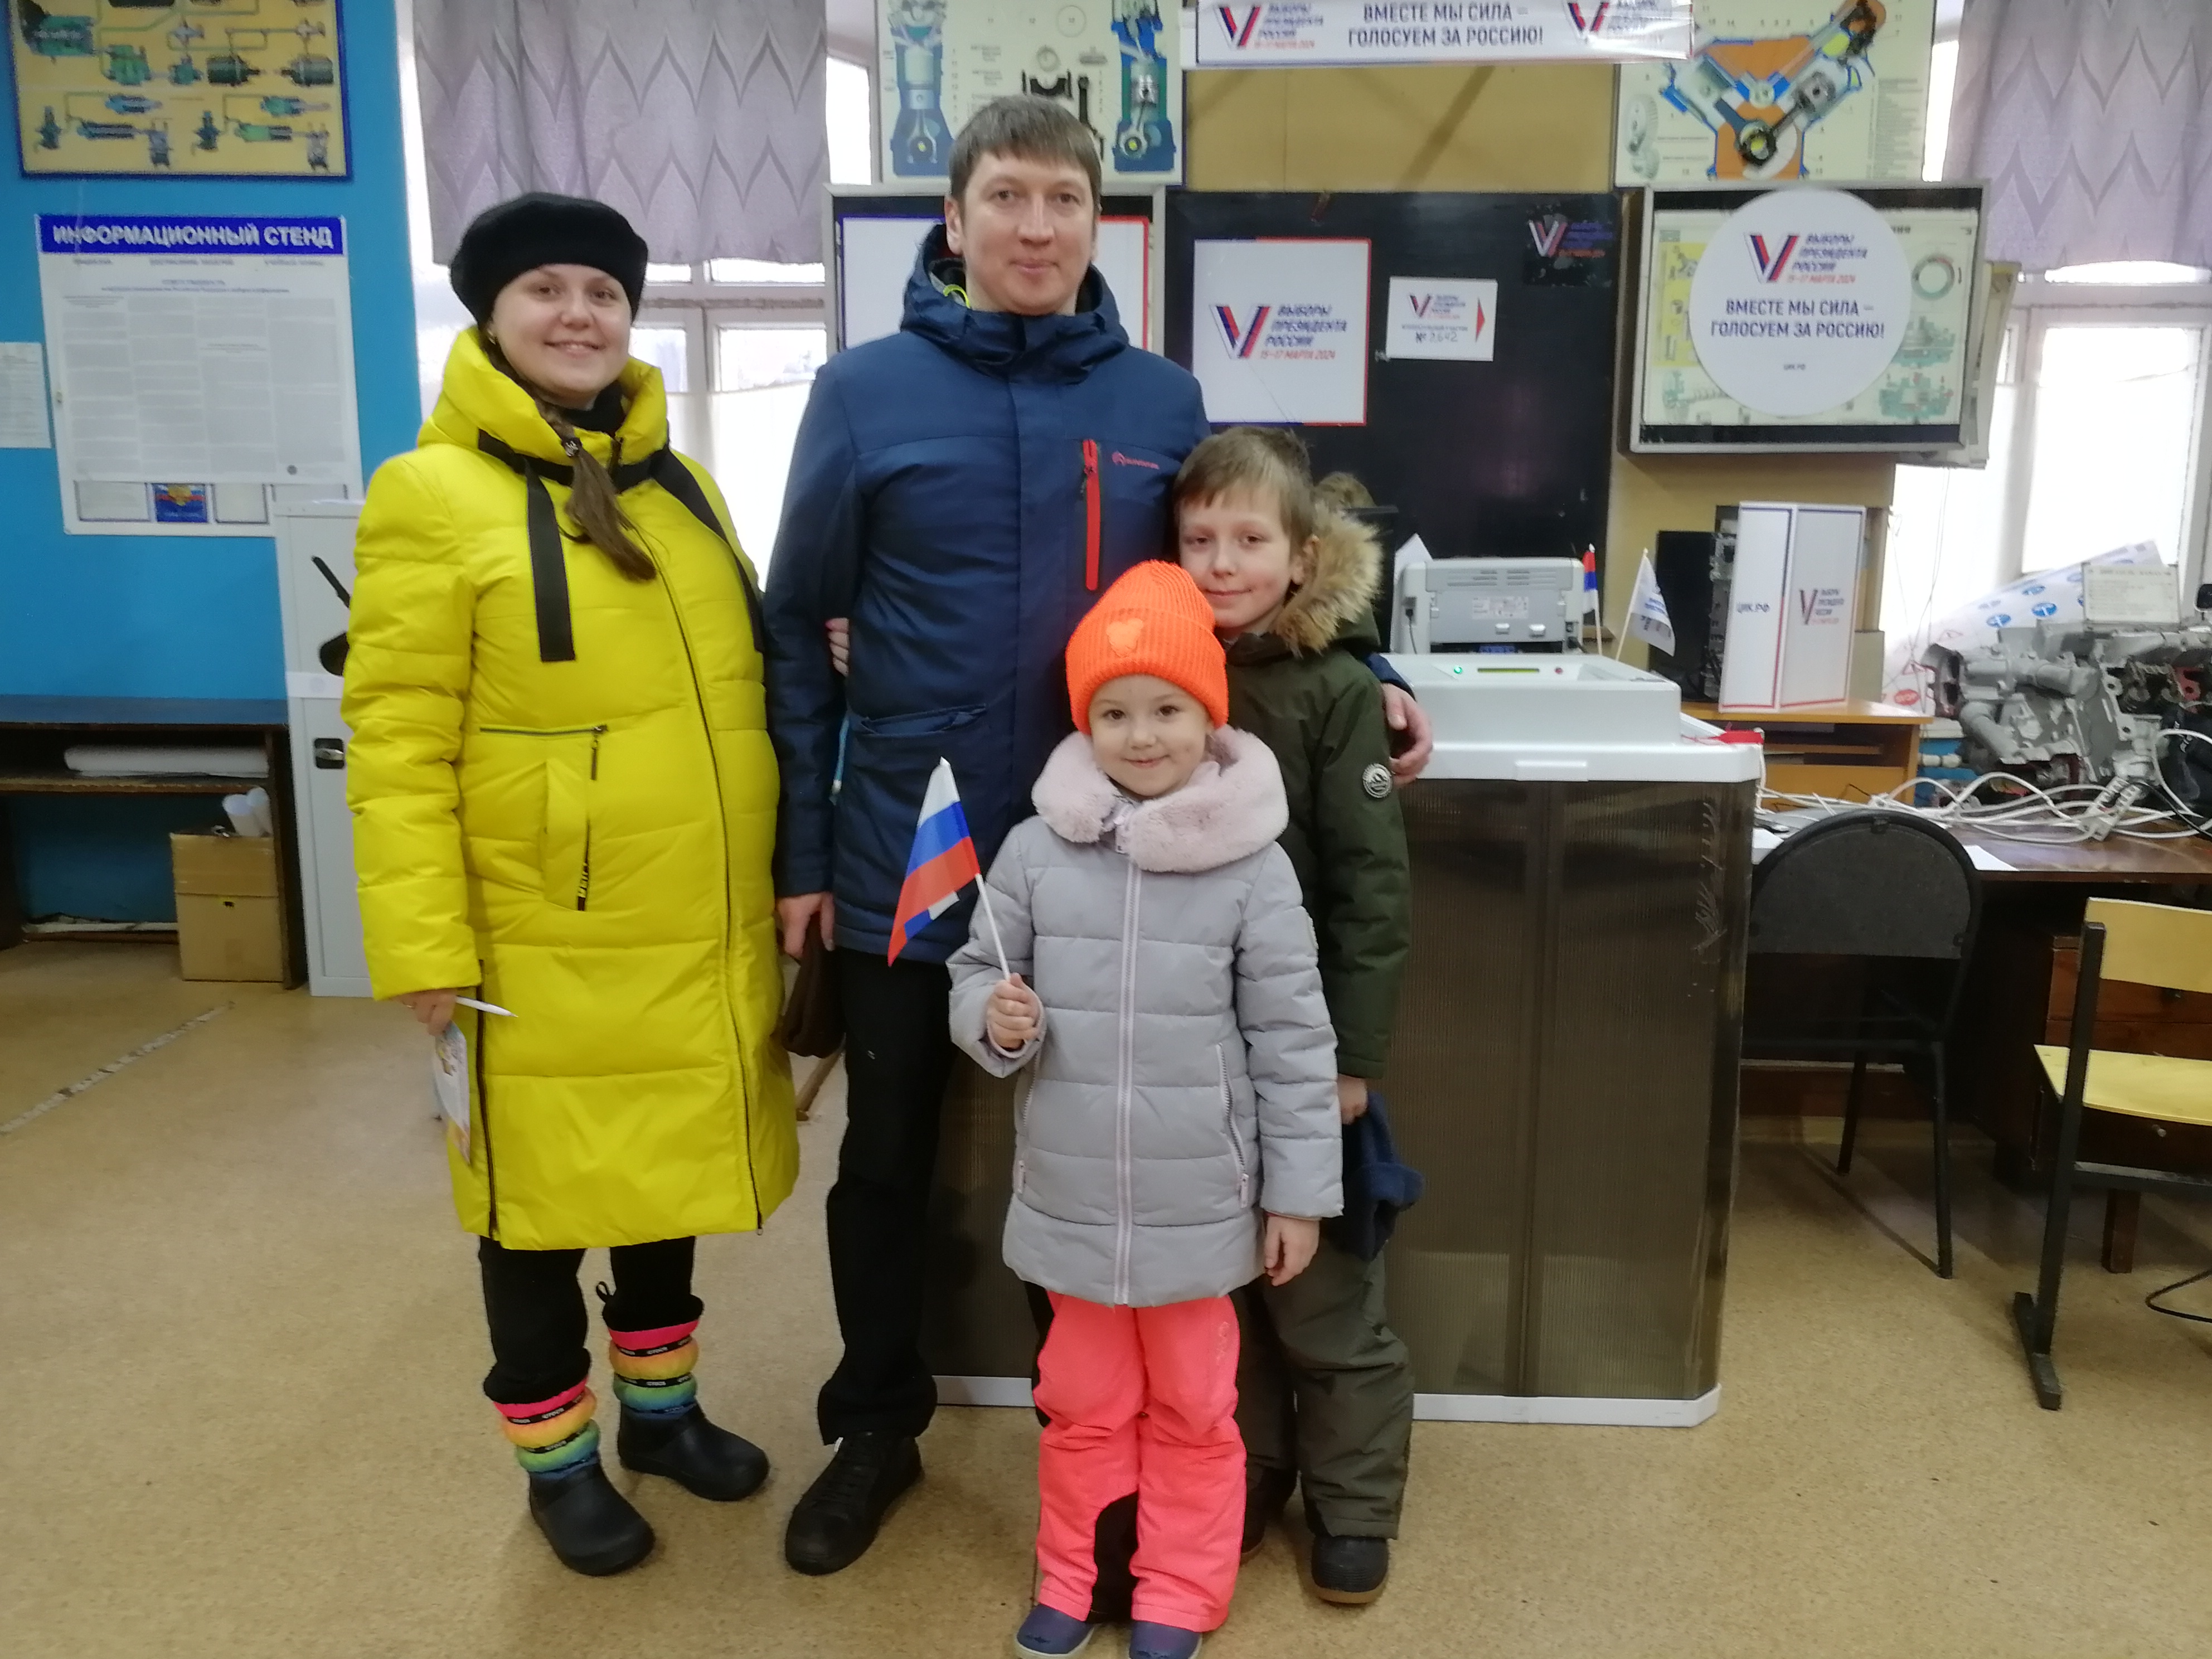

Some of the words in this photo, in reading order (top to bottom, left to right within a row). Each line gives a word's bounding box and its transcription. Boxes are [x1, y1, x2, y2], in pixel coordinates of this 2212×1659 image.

[1364, 2, 1428, 23] ВМЕСТЕ
[1433, 2, 1462, 22] МЫ
[1468, 2, 1512, 22] СИЛА
[1348, 27, 1435, 47] ГОЛОСУЕМ
[1442, 28, 1462, 47] ЗА
[1466, 27, 1543, 47] РОССИЮ!
[53, 224, 260, 249] ИНФОРМАЦИОННЫЙ
[264, 226, 334, 249] СТЕНД
[1726, 299, 1784, 315] ВМЕСТЕ
[1788, 299, 1815, 316] МЫ
[1820, 300, 1859, 316] СИЛА
[1711, 319, 1789, 337] ГОЛОСУЕМ
[1793, 322, 1811, 337] ЗА
[1816, 322, 1885, 339] РОССИЮ!
